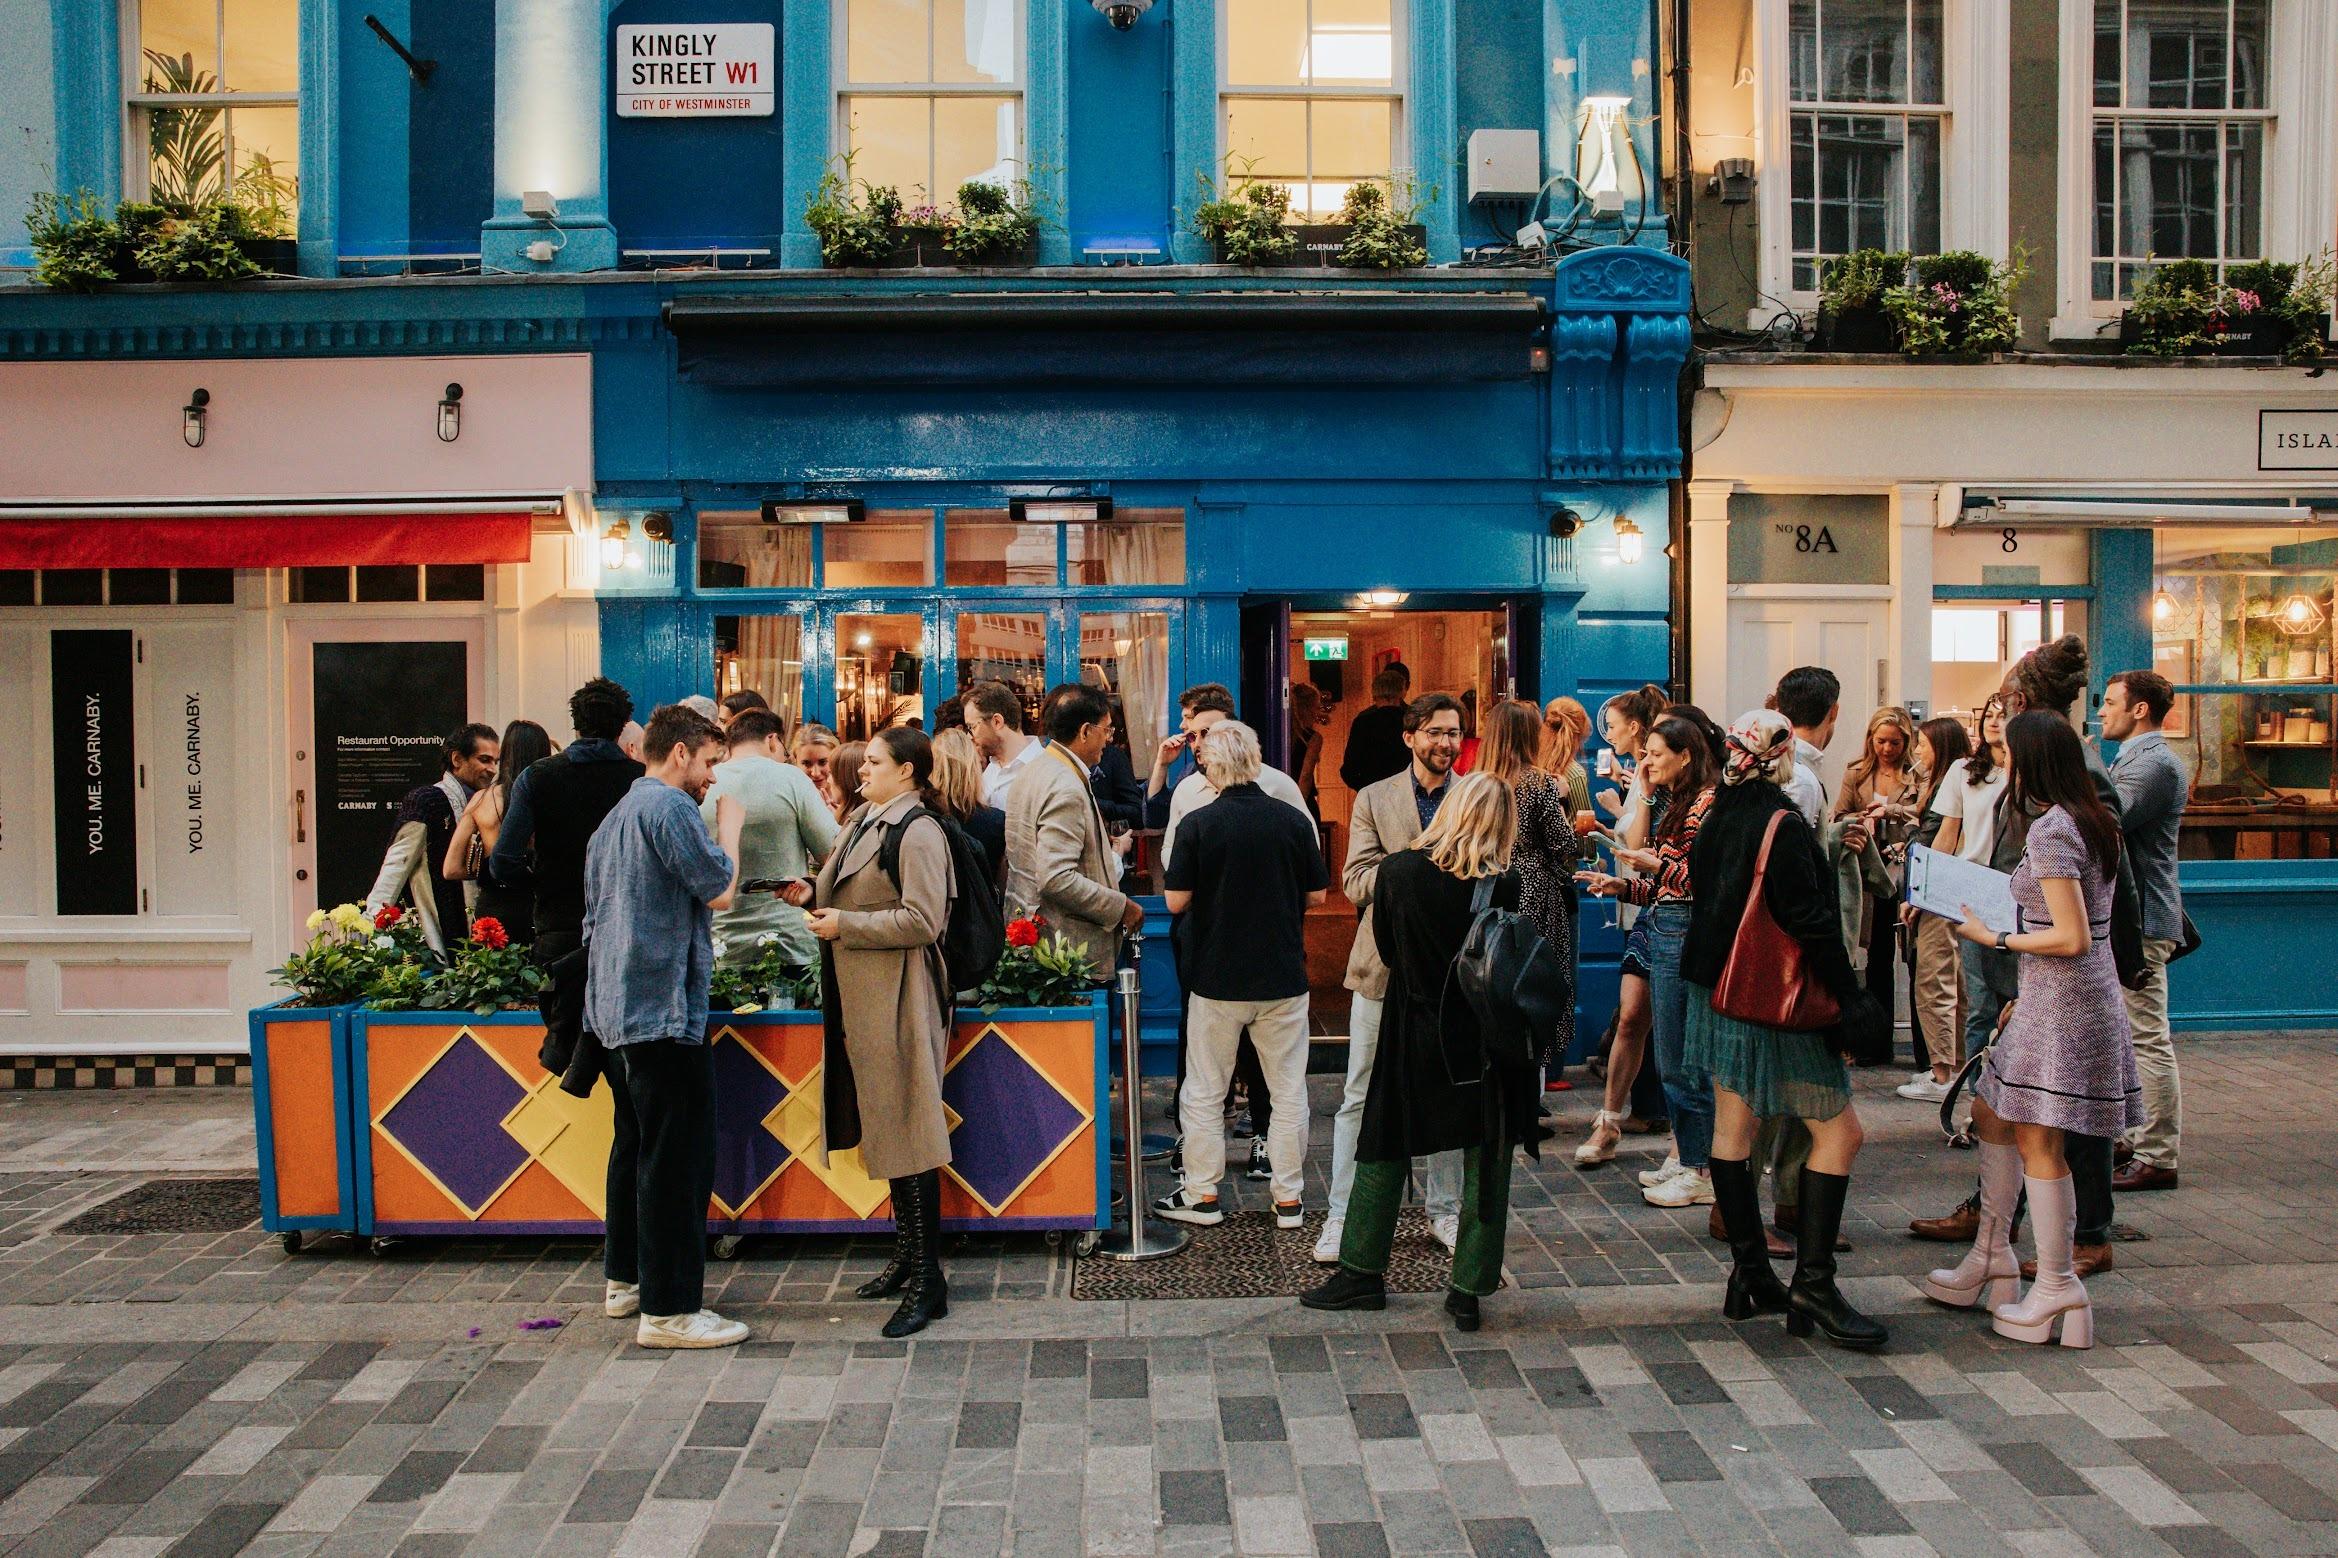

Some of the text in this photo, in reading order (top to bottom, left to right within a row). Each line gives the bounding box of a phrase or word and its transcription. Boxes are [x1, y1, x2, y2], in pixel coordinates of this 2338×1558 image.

[632, 34, 717, 56] KINGLY
[632, 62, 758, 85] STREET W1
[632, 98, 751, 110] CITY OF WESTMINSTER
[1306, 243, 1344, 251] CARNABY
[2277, 433, 2338, 448] ISLA
[1795, 525, 1839, 553] 8A
[2001, 527, 2018, 553] 8
[337, 735, 446, 747] Restaurant Opportunity
[86, 692, 103, 856] YOU. ME. CARNABY.
[186, 691, 203, 854] YOU. ME. CARNABY.
[337, 801, 378, 810] CARNABY
